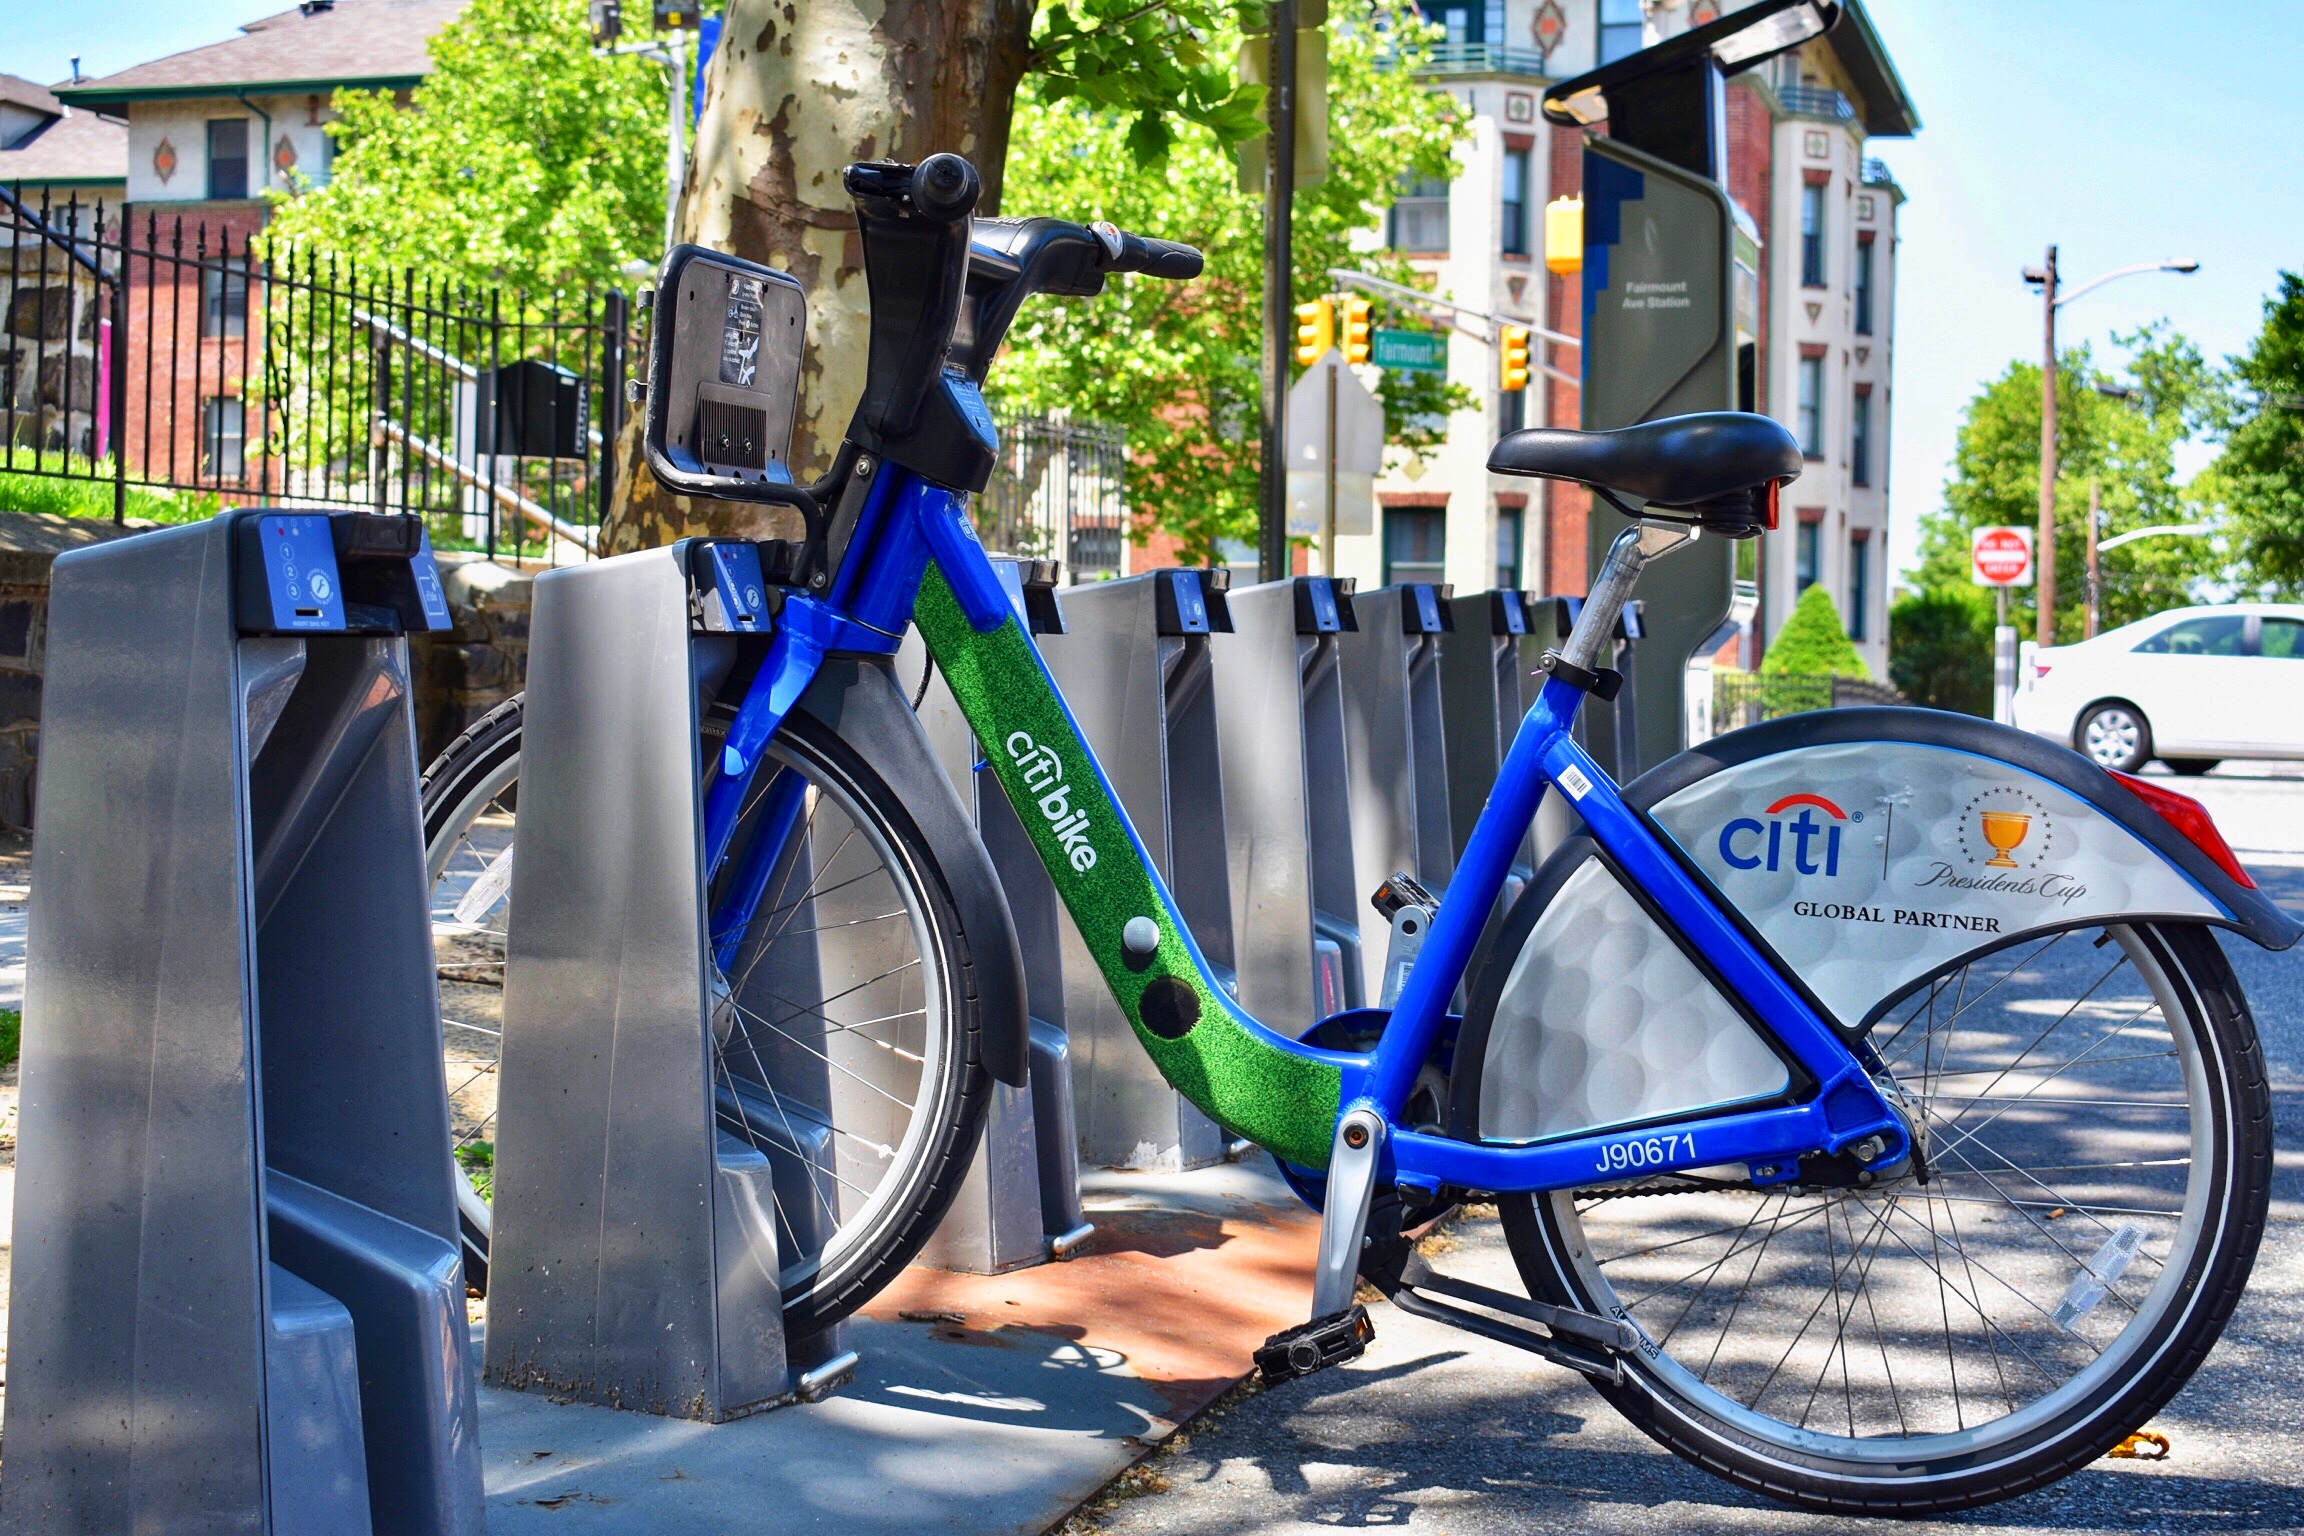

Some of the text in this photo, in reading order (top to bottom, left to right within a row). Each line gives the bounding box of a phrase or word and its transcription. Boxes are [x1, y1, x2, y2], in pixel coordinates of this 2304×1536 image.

[1625, 281, 1687, 294] Fairmount
[1622, 296, 1690, 309] Ave Station
[1379, 337, 1432, 364] Fairmount
[1980, 538, 2018, 550] DO NOT
[287, 566, 294, 577] 2
[290, 585, 297, 596] 3
[1007, 731, 1097, 872] citi bike
[1914, 861, 2087, 906] Presidents Cup
[1793, 901, 2002, 933] GLOBAL PARTNER
[1595, 1132, 1696, 1172] J90671
